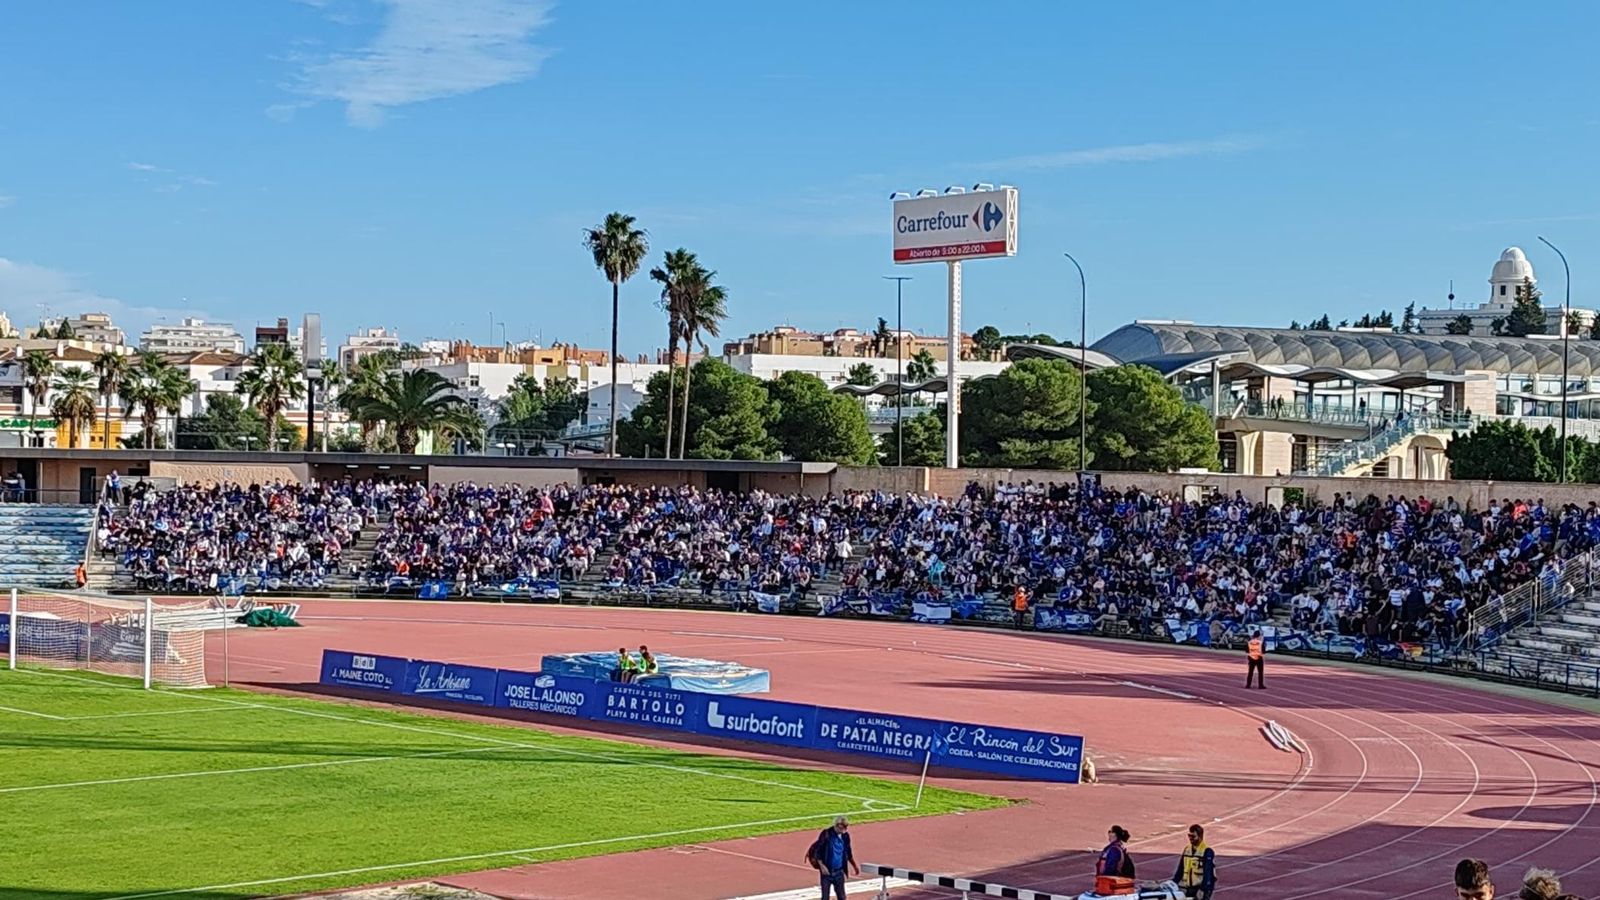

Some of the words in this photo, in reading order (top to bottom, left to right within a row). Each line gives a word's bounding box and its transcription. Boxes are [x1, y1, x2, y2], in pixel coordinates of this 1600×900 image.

[897, 211, 968, 233] Carrefour
[909, 248, 932, 258] Abierto
[932, 249, 940, 257] de
[331, 667, 338, 677] J.
[339, 669, 363, 681] MAINE
[363, 672, 385, 683] COTO
[418, 665, 431, 689] La
[504, 684, 531, 699] JOSE
[532, 687, 540, 701] L.
[541, 689, 585, 706] ALONSO
[614, 687, 646, 696] CANTINA
[509, 698, 539, 710] TALLERES
[540, 702, 577, 715] MECÁNICOS
[608, 695, 685, 716] BARTOLO
[606, 709, 627, 718] PLAYA
[630, 712, 639, 720] DE
[653, 715, 683, 725] CASERÍA
[727, 714, 804, 739] surbafont
[821, 723, 838, 738] DE
[843, 726, 877, 743] PATA
[947, 725, 966, 745] El
[970, 728, 1019, 751] Rincón
[1022, 737, 1045, 754] del
[1047, 736, 1078, 757] Sur
[837, 741, 883, 753] CHARCUTERÍA
[977, 751, 1001, 761] SALÓN
[1003, 754, 1014, 763] DE
[1014, 756, 1078, 771] CELEBRACIONES
